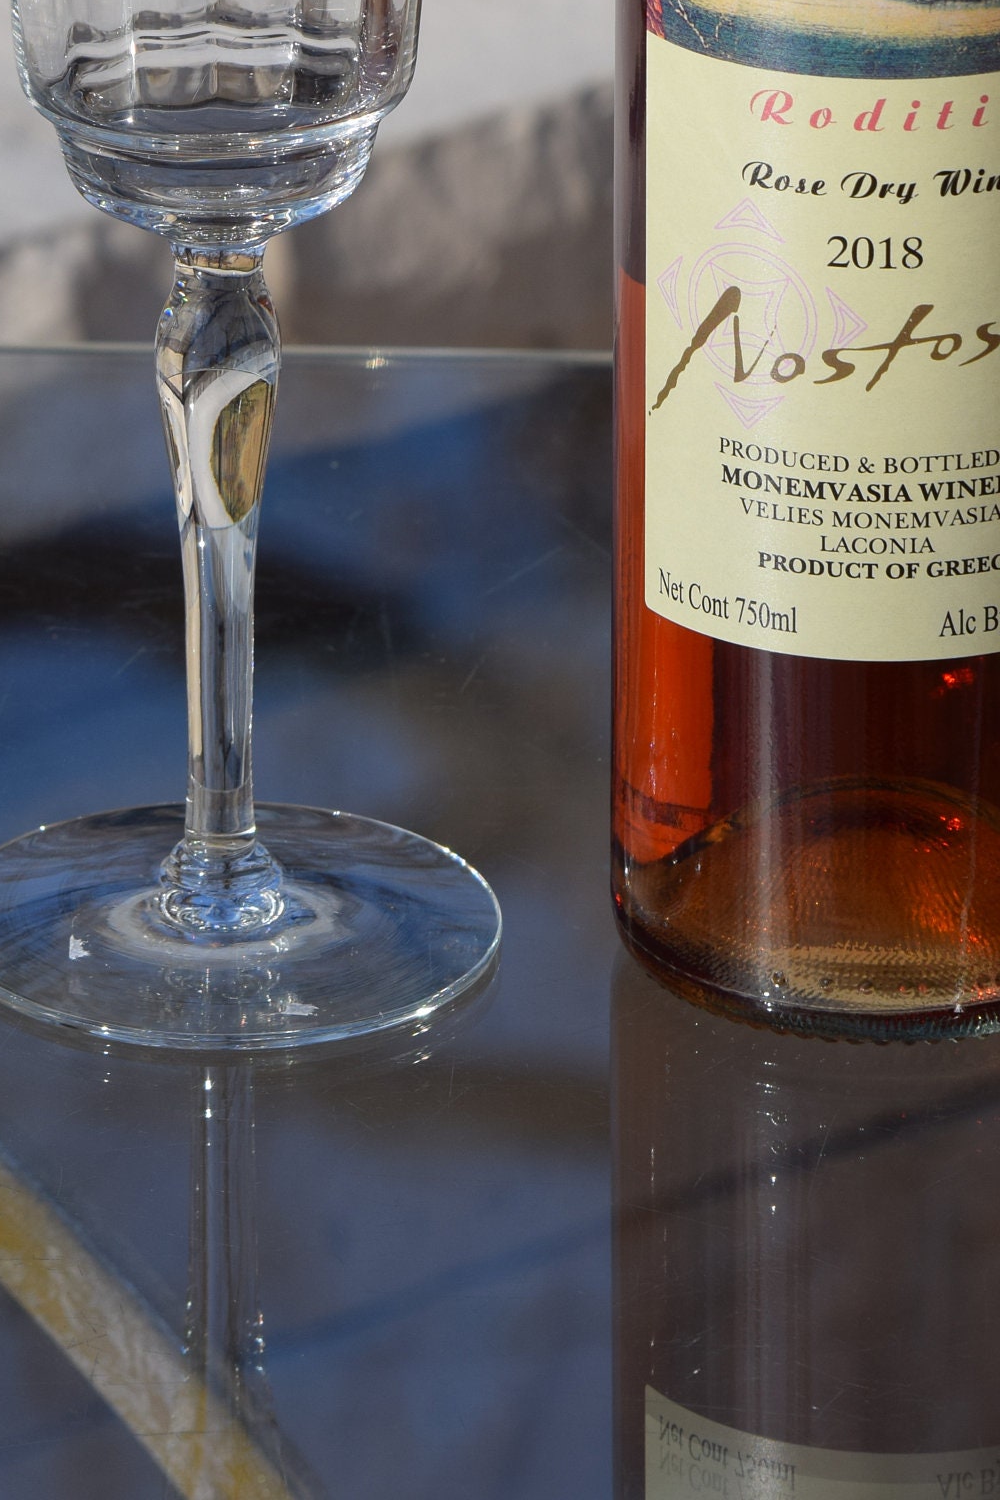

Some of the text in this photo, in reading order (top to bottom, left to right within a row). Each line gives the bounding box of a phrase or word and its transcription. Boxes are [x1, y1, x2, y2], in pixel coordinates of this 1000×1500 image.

[742, 161, 827, 196] Rose
[841, 171, 919, 205] Dry
[827, 236, 923, 269] 2018
[649, 286, 1000, 415] Nostos
[719, 437, 1000, 474] PRODUCED & BOTTLED
[721, 464, 1000, 503] MONEMVASIA WINE
[739, 498, 824, 526] VELIES
[820, 535, 935, 554] LACONIA
[758, 551, 879, 580] PRODUCT
[886, 563, 920, 580] OF
[659, 568, 798, 633] Net Cont 750ml
[939, 608, 976, 637] Alc
